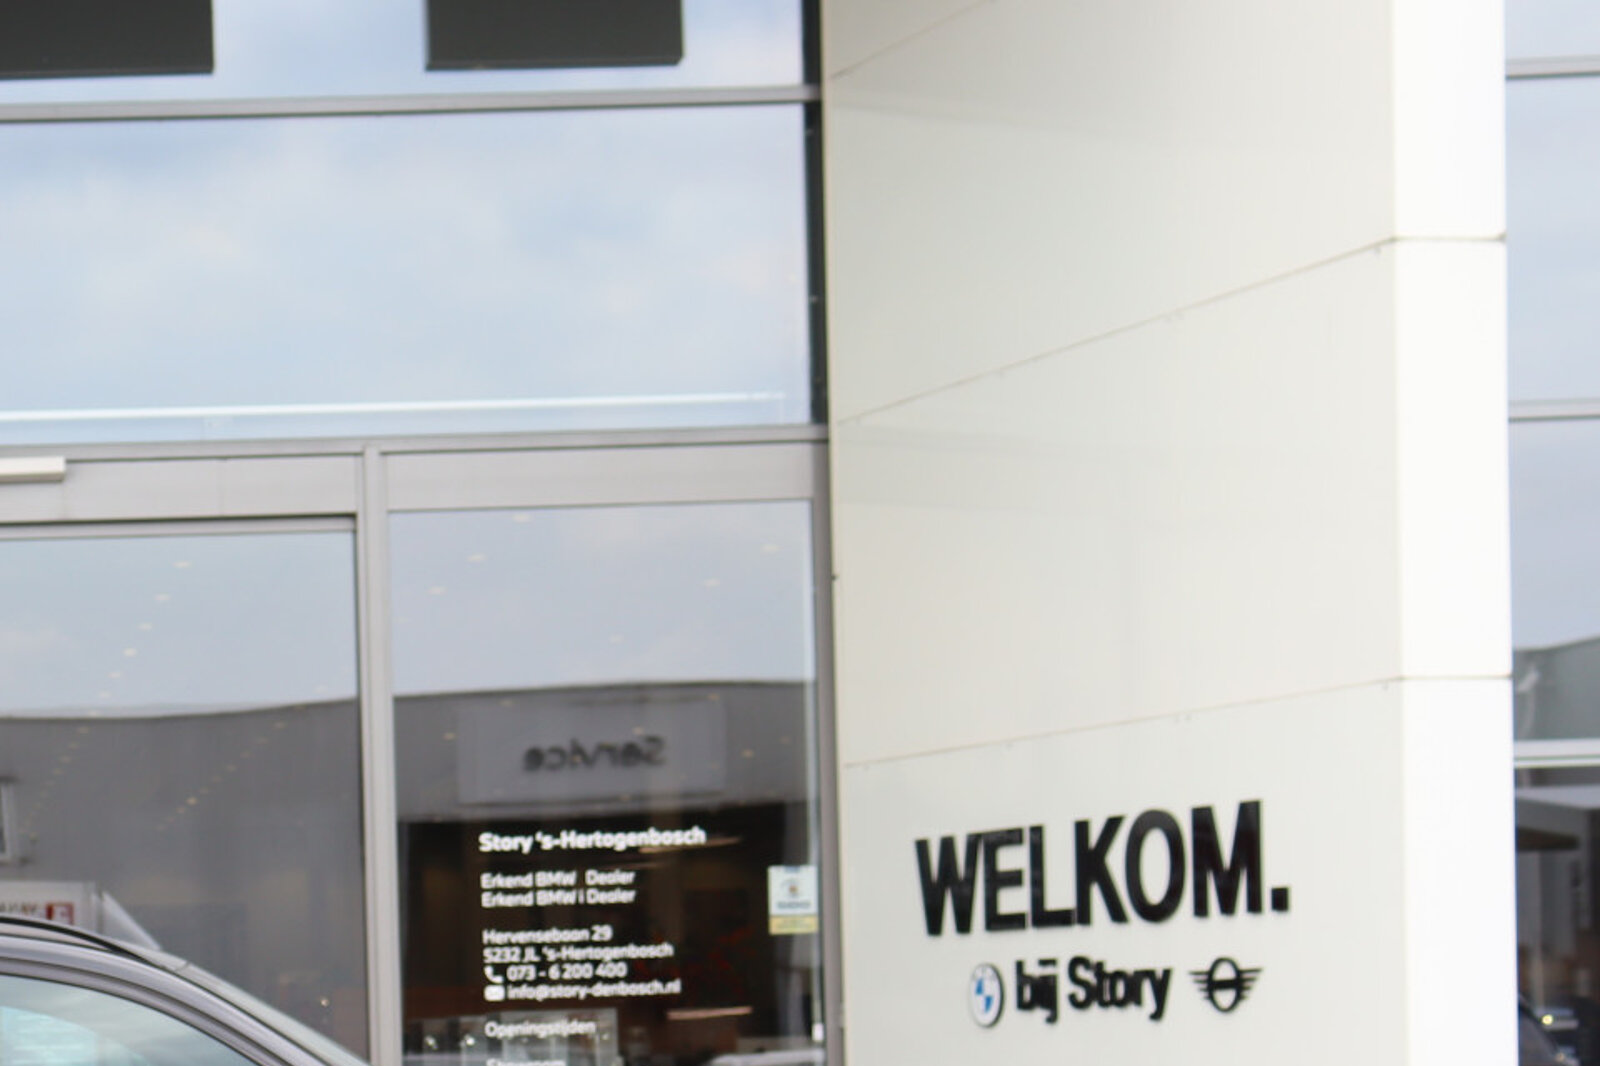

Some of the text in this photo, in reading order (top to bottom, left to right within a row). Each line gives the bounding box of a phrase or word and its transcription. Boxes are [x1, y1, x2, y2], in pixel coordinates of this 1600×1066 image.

[478, 832, 534, 855] Story
[480, 867, 636, 889] Erkend BMW Dealer
[915, 799, 1290, 936] WELKOM.
[481, 890, 535, 908] Erkend
[536, 889, 576, 905] BMW
[586, 887, 637, 904] Dealer
[591, 924, 614, 941] 29
[483, 946, 522, 963] 5232
[523, 946, 541, 963] JL
[506, 964, 537, 981] 073
[548, 963, 561, 980] 6
[562, 962, 594, 979] 200
[595, 961, 628, 978] 400
[1015, 956, 1172, 1024] bij Story
[485, 1019, 597, 1038] Openingstijden
